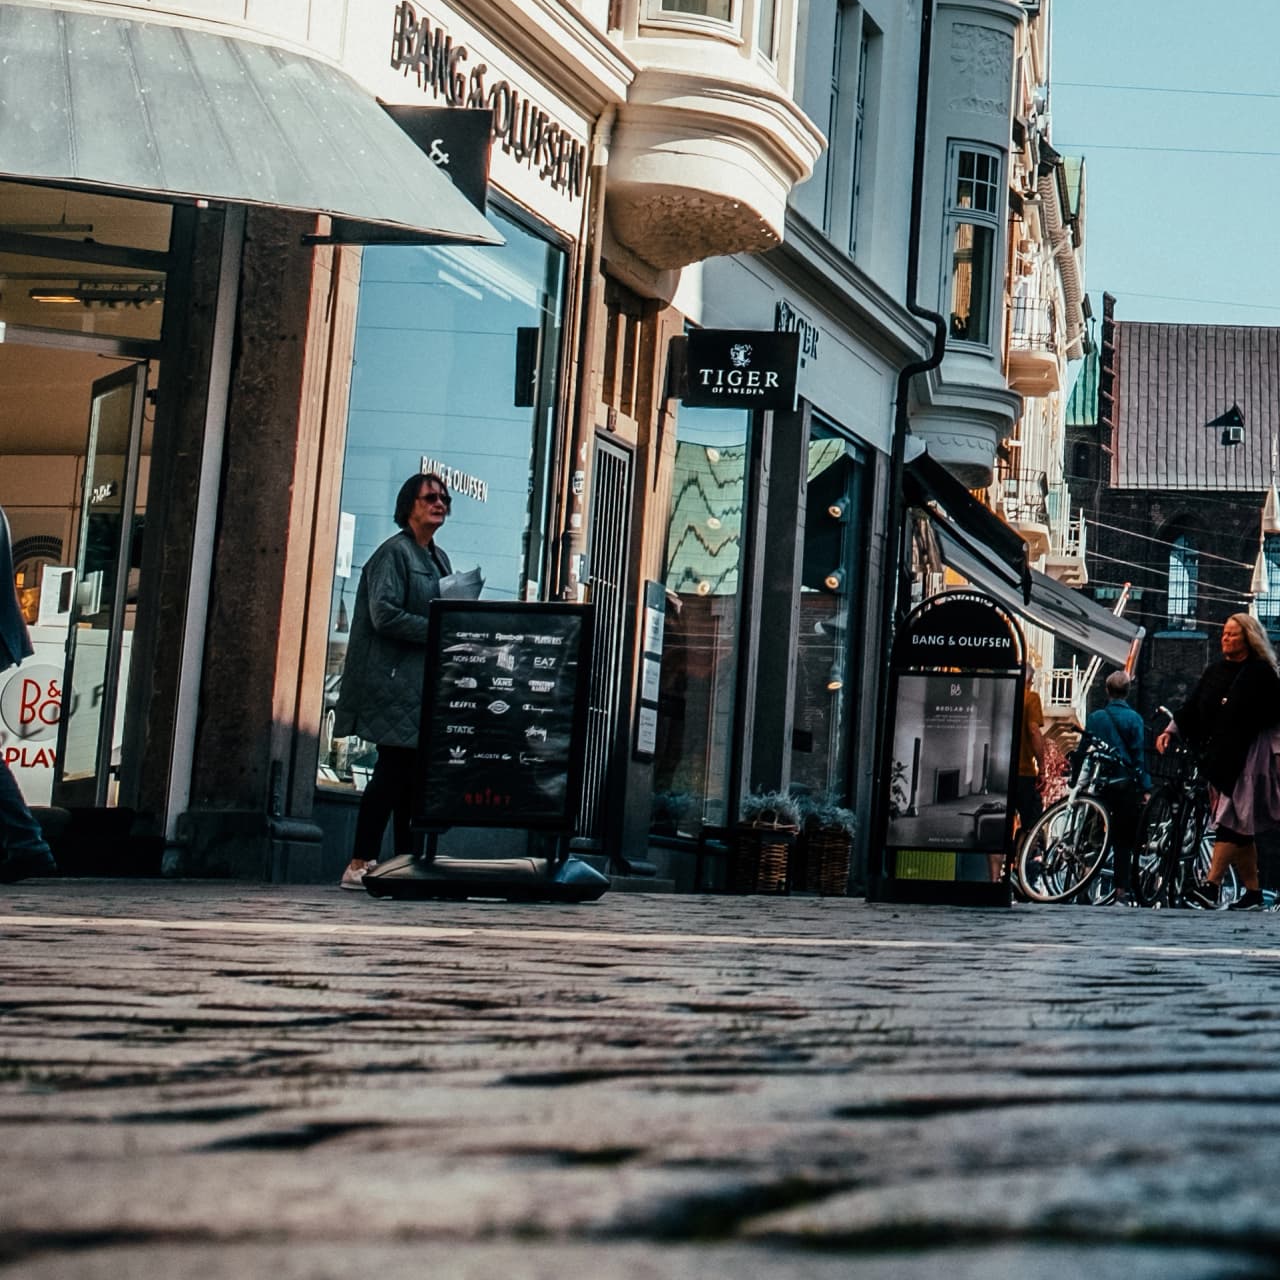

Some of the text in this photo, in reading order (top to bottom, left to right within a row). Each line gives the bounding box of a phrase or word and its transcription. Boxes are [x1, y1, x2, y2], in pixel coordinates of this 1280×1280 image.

[391, 0, 468, 107] BANG
[487, 80, 585, 202] OLUFSEN
[428, 138, 450, 166] &
[700, 369, 780, 388] TIGER
[712, 386, 765, 395] OF SWEDEN
[421, 456, 446, 483] BANG
[453, 470, 488, 503] OLUFSEN
[912, 634, 1011, 648] BANG & OLUFSEN
[534, 657, 556, 667] EA7
[491, 677, 514, 687] VANS
[446, 725, 475, 734] STATIC
